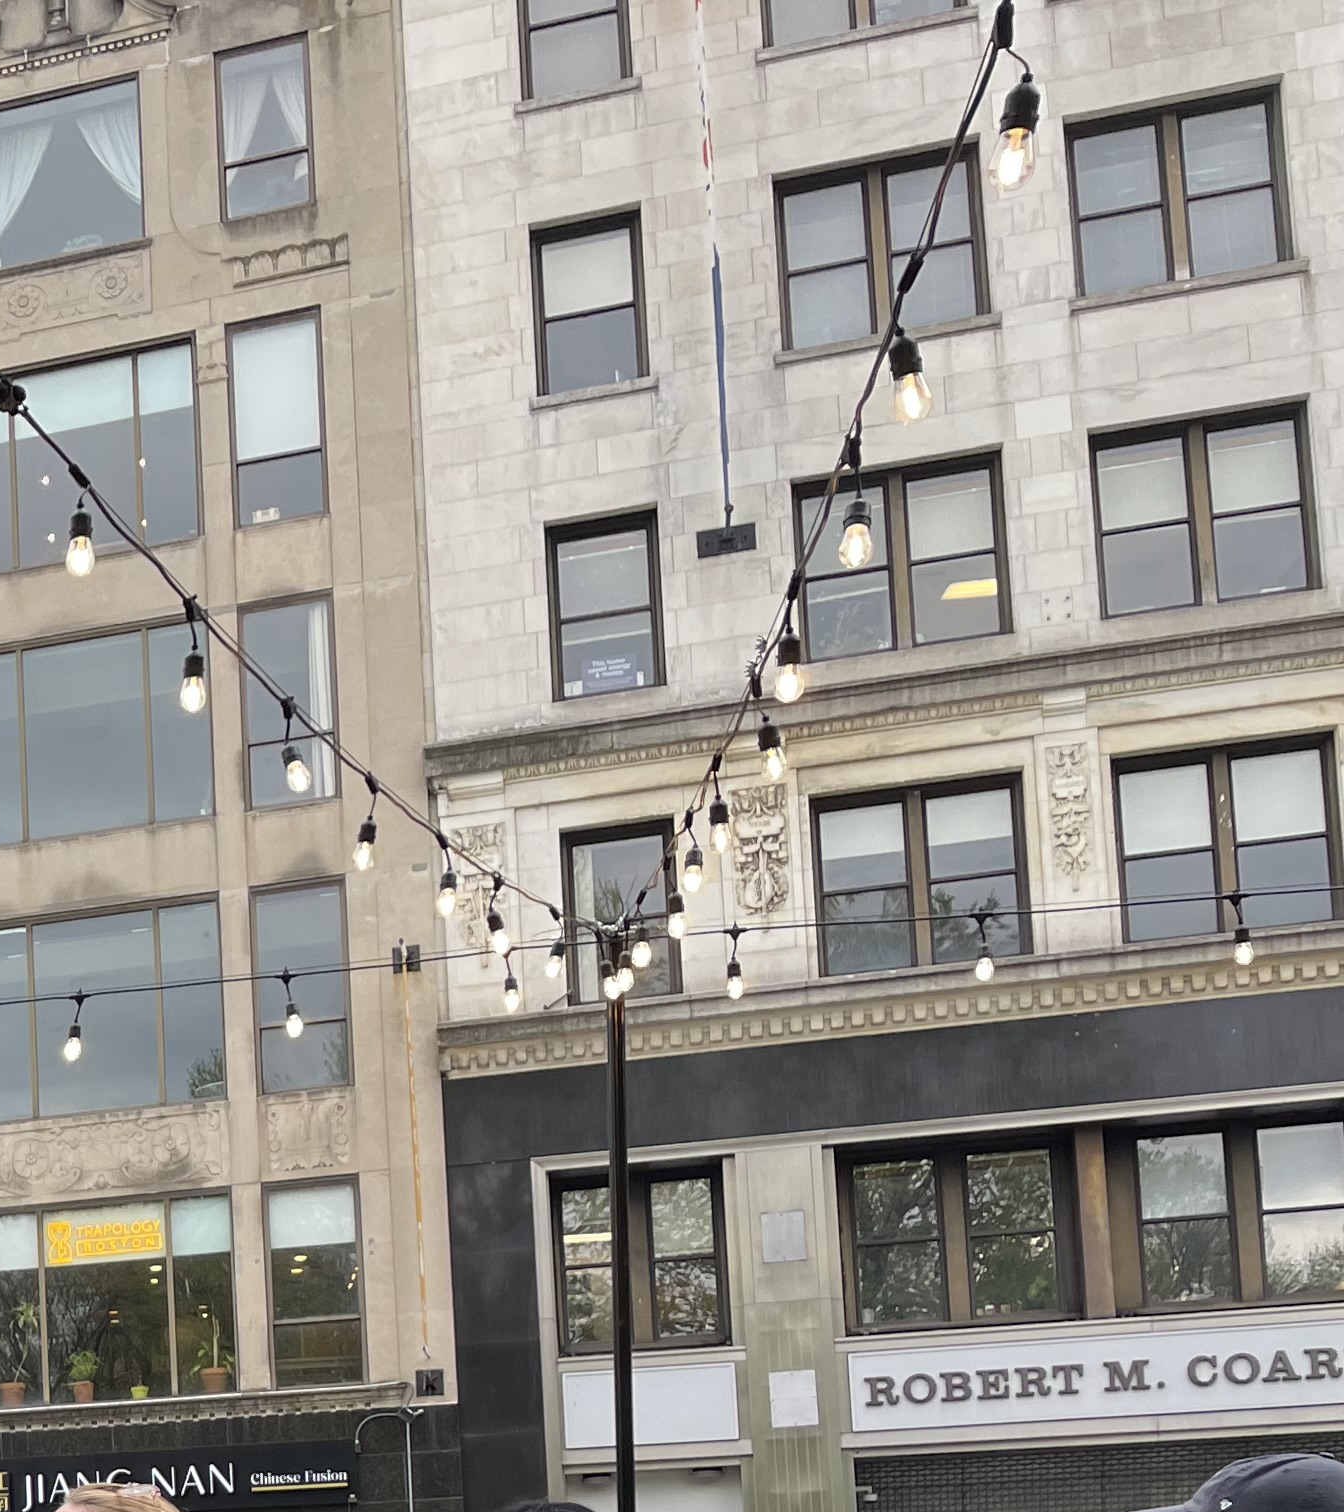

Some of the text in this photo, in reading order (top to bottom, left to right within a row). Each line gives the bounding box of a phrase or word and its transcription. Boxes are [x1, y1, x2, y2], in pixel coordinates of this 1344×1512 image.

[75, 1219, 161, 1237] TRAPOLOGY
[83, 1237, 155, 1253] BOSTON
[863, 1363, 1085, 1408] ROBERT
[1103, 1359, 1166, 1393] M.
[151, 1462, 235, 1497] NAN
[250, 1472, 302, 1486] Chinese
[304, 1468, 348, 1483] Fusion
